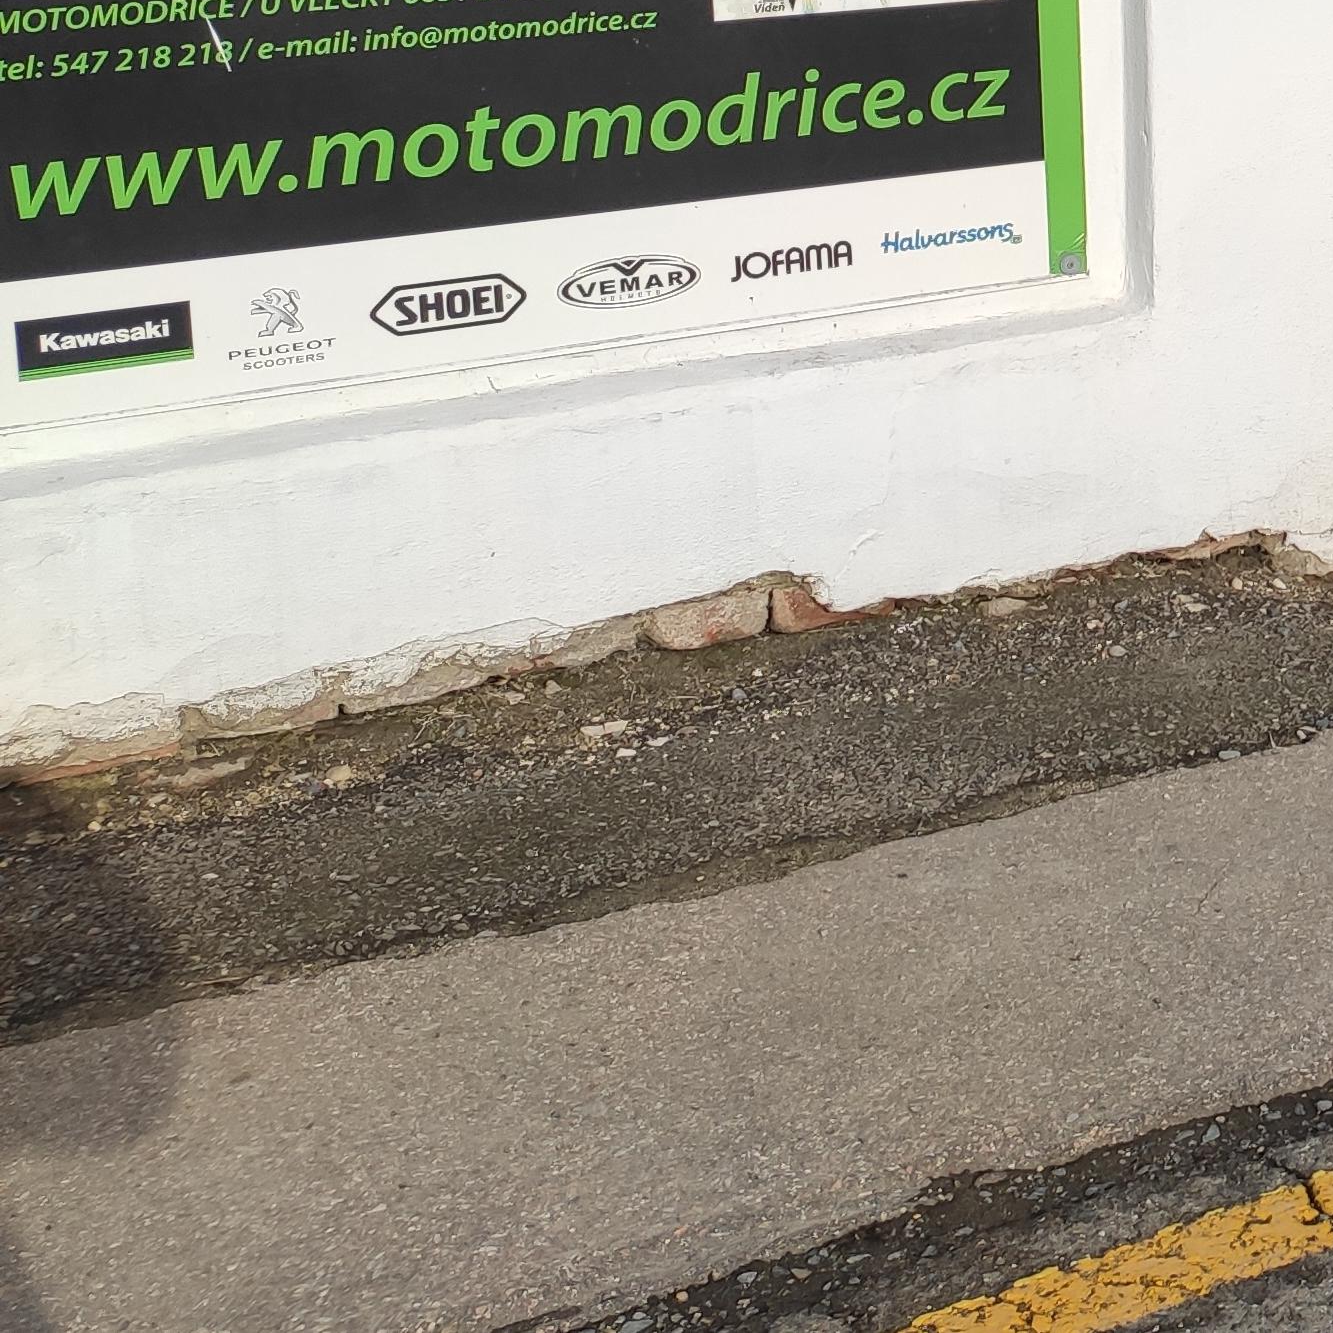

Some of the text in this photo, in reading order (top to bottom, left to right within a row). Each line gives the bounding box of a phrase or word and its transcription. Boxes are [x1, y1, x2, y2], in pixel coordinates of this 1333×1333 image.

[50, 50, 109, 78] 547
[114, 45, 171, 72] 218
[177, 40, 233, 68] 218
[257, 29, 358, 60] e-mail:
[363, 11, 659, 51] info@motomodrice.cz
[10, 66, 1010, 223] www.motomodrice.cz
[879, 220, 1015, 255] Halvarssons
[730, 240, 853, 283] JOFAMA
[576, 270, 684, 298] VEMAR
[394, 282, 505, 327] SHOEI
[39, 318, 170, 354] Kawasaki
[228, 337, 336, 361] PEUGEOT
[242, 351, 325, 371] SCOOTERS
